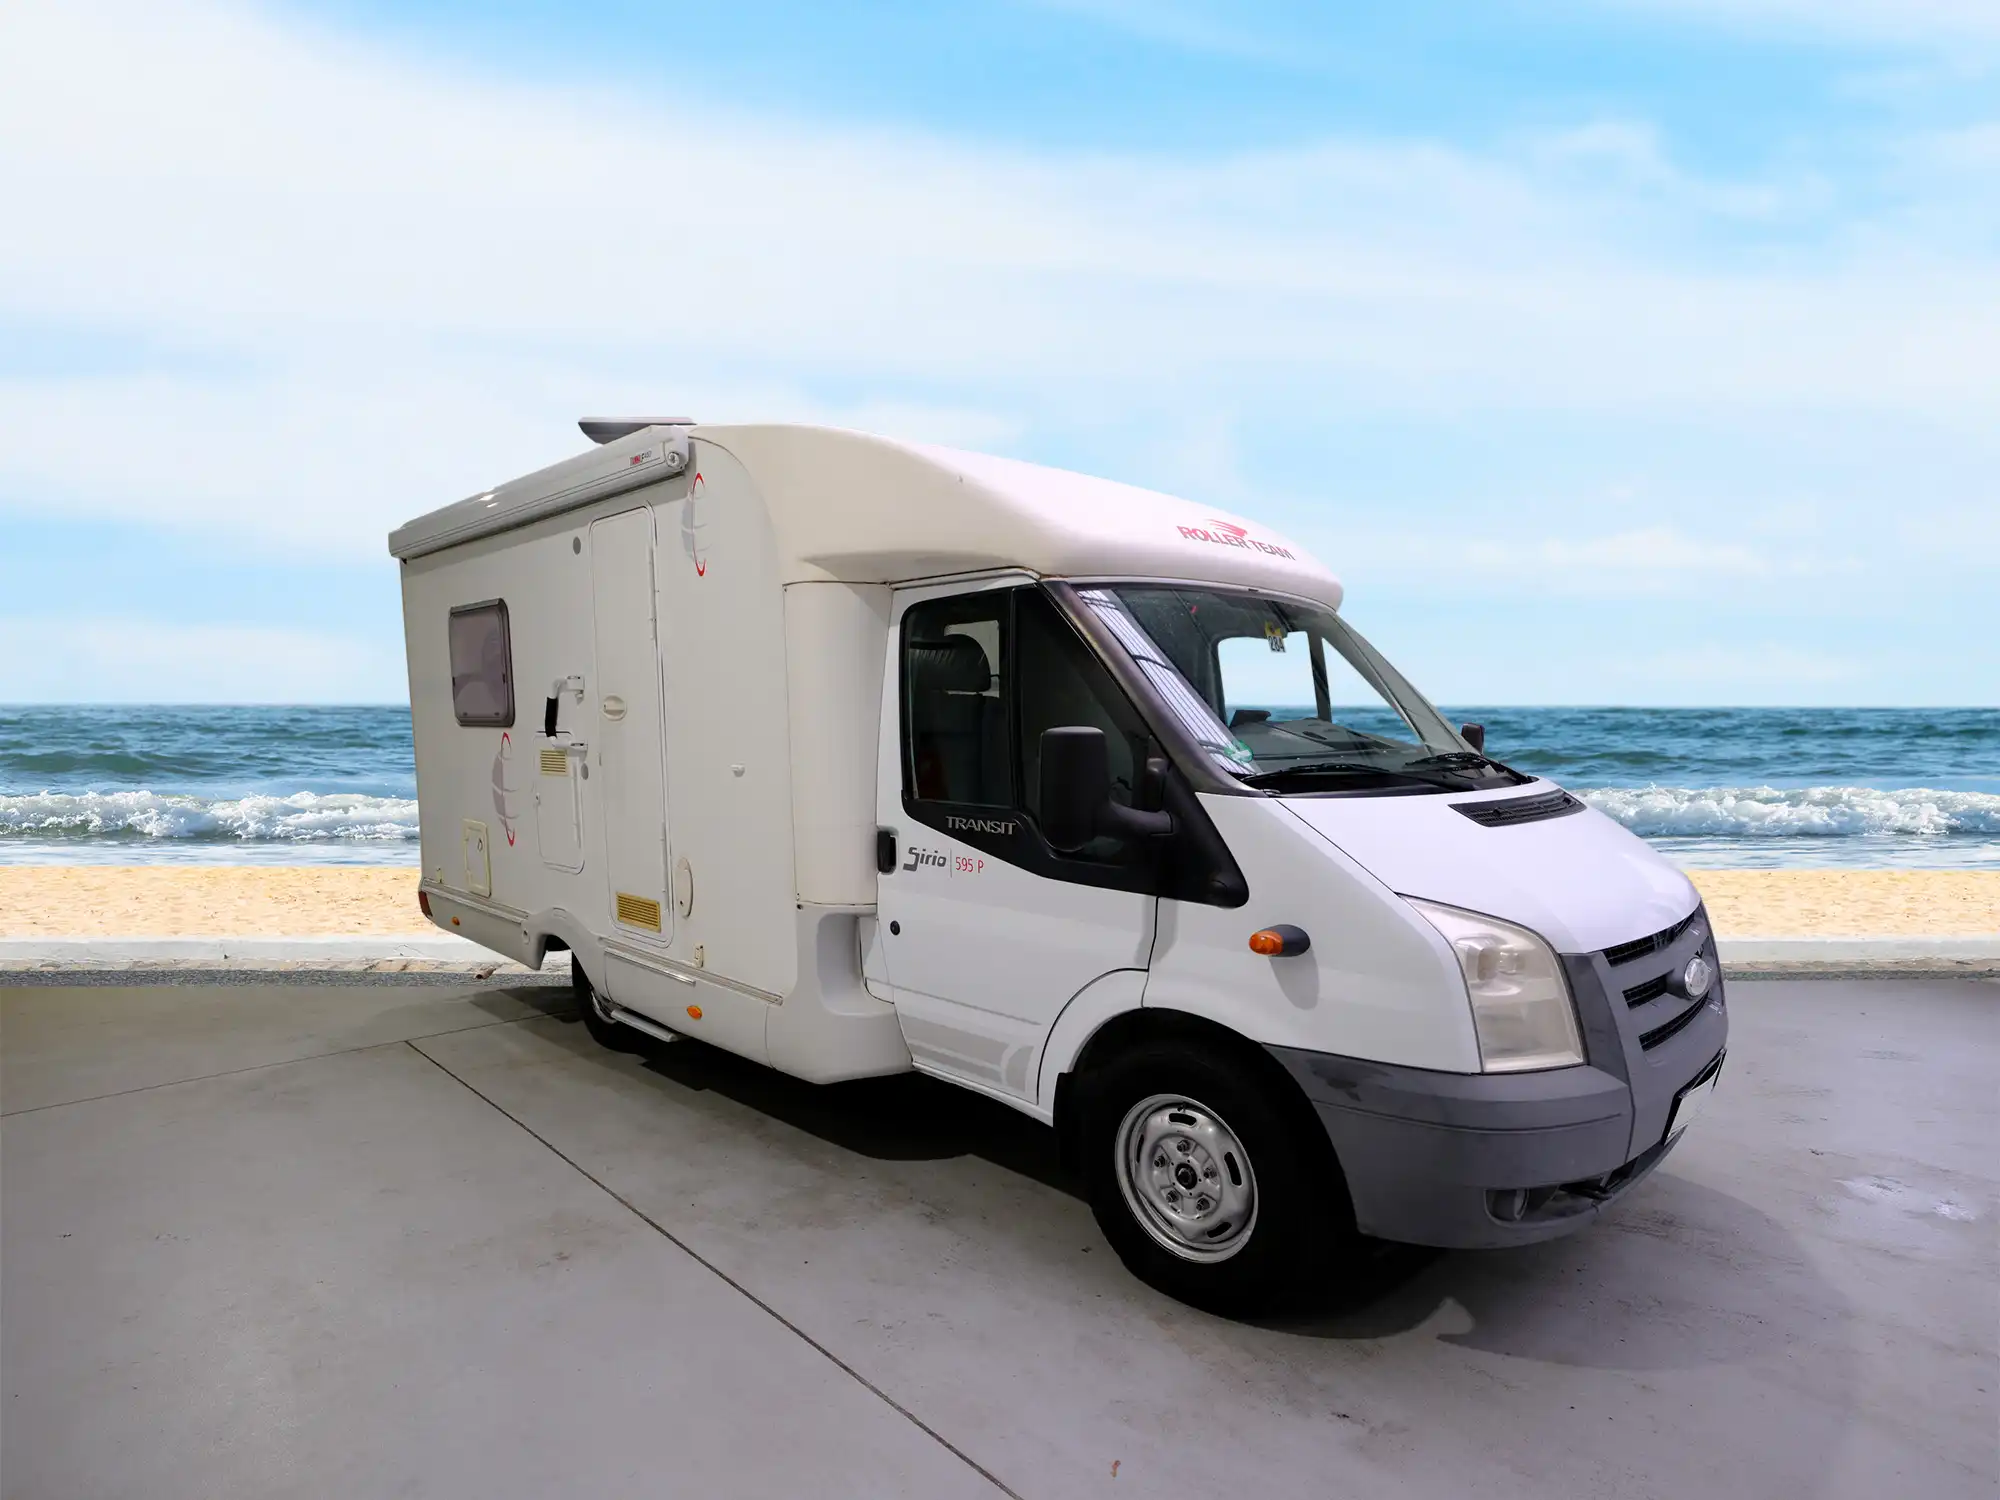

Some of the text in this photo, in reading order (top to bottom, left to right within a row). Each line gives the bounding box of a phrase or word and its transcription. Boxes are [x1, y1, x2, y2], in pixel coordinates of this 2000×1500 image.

[1176, 525, 1297, 561] ROLLER TEAM
[945, 815, 1016, 835] TRANSIT
[903, 846, 985, 873] Sirio 595 P
